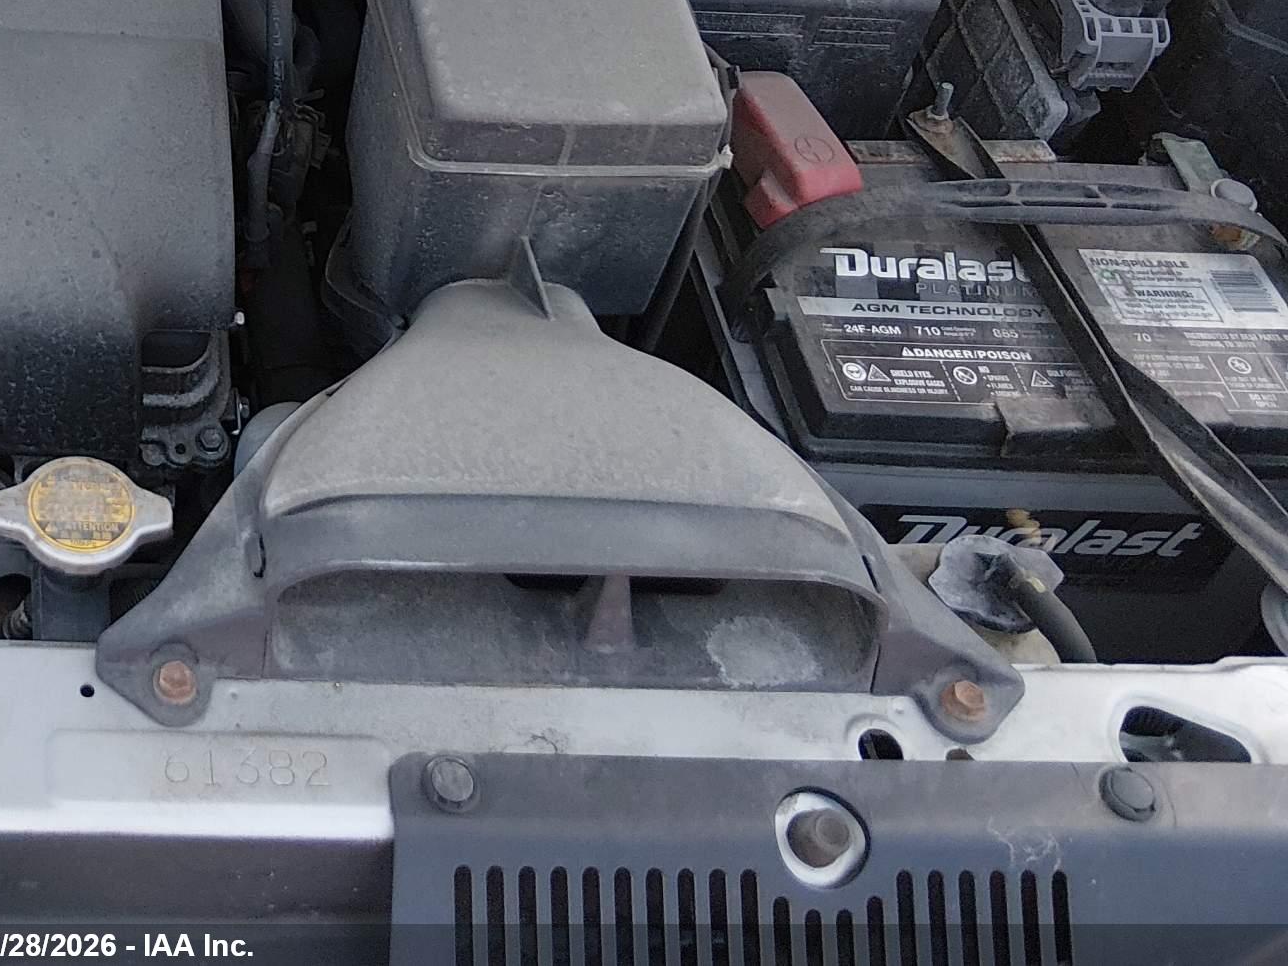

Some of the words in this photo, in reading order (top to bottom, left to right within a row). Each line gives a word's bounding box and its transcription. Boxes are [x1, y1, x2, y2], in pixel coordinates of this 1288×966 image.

[1089, 257, 1189, 269] NON-SPILLABLE
[851, 303, 899, 313] AGM
[907, 304, 1047, 318] TECHNOLOGY
[843, 324, 902, 335] 24F-AGM
[914, 325, 941, 336] 710
[915, 348, 1032, 360] DANGER/POISON
